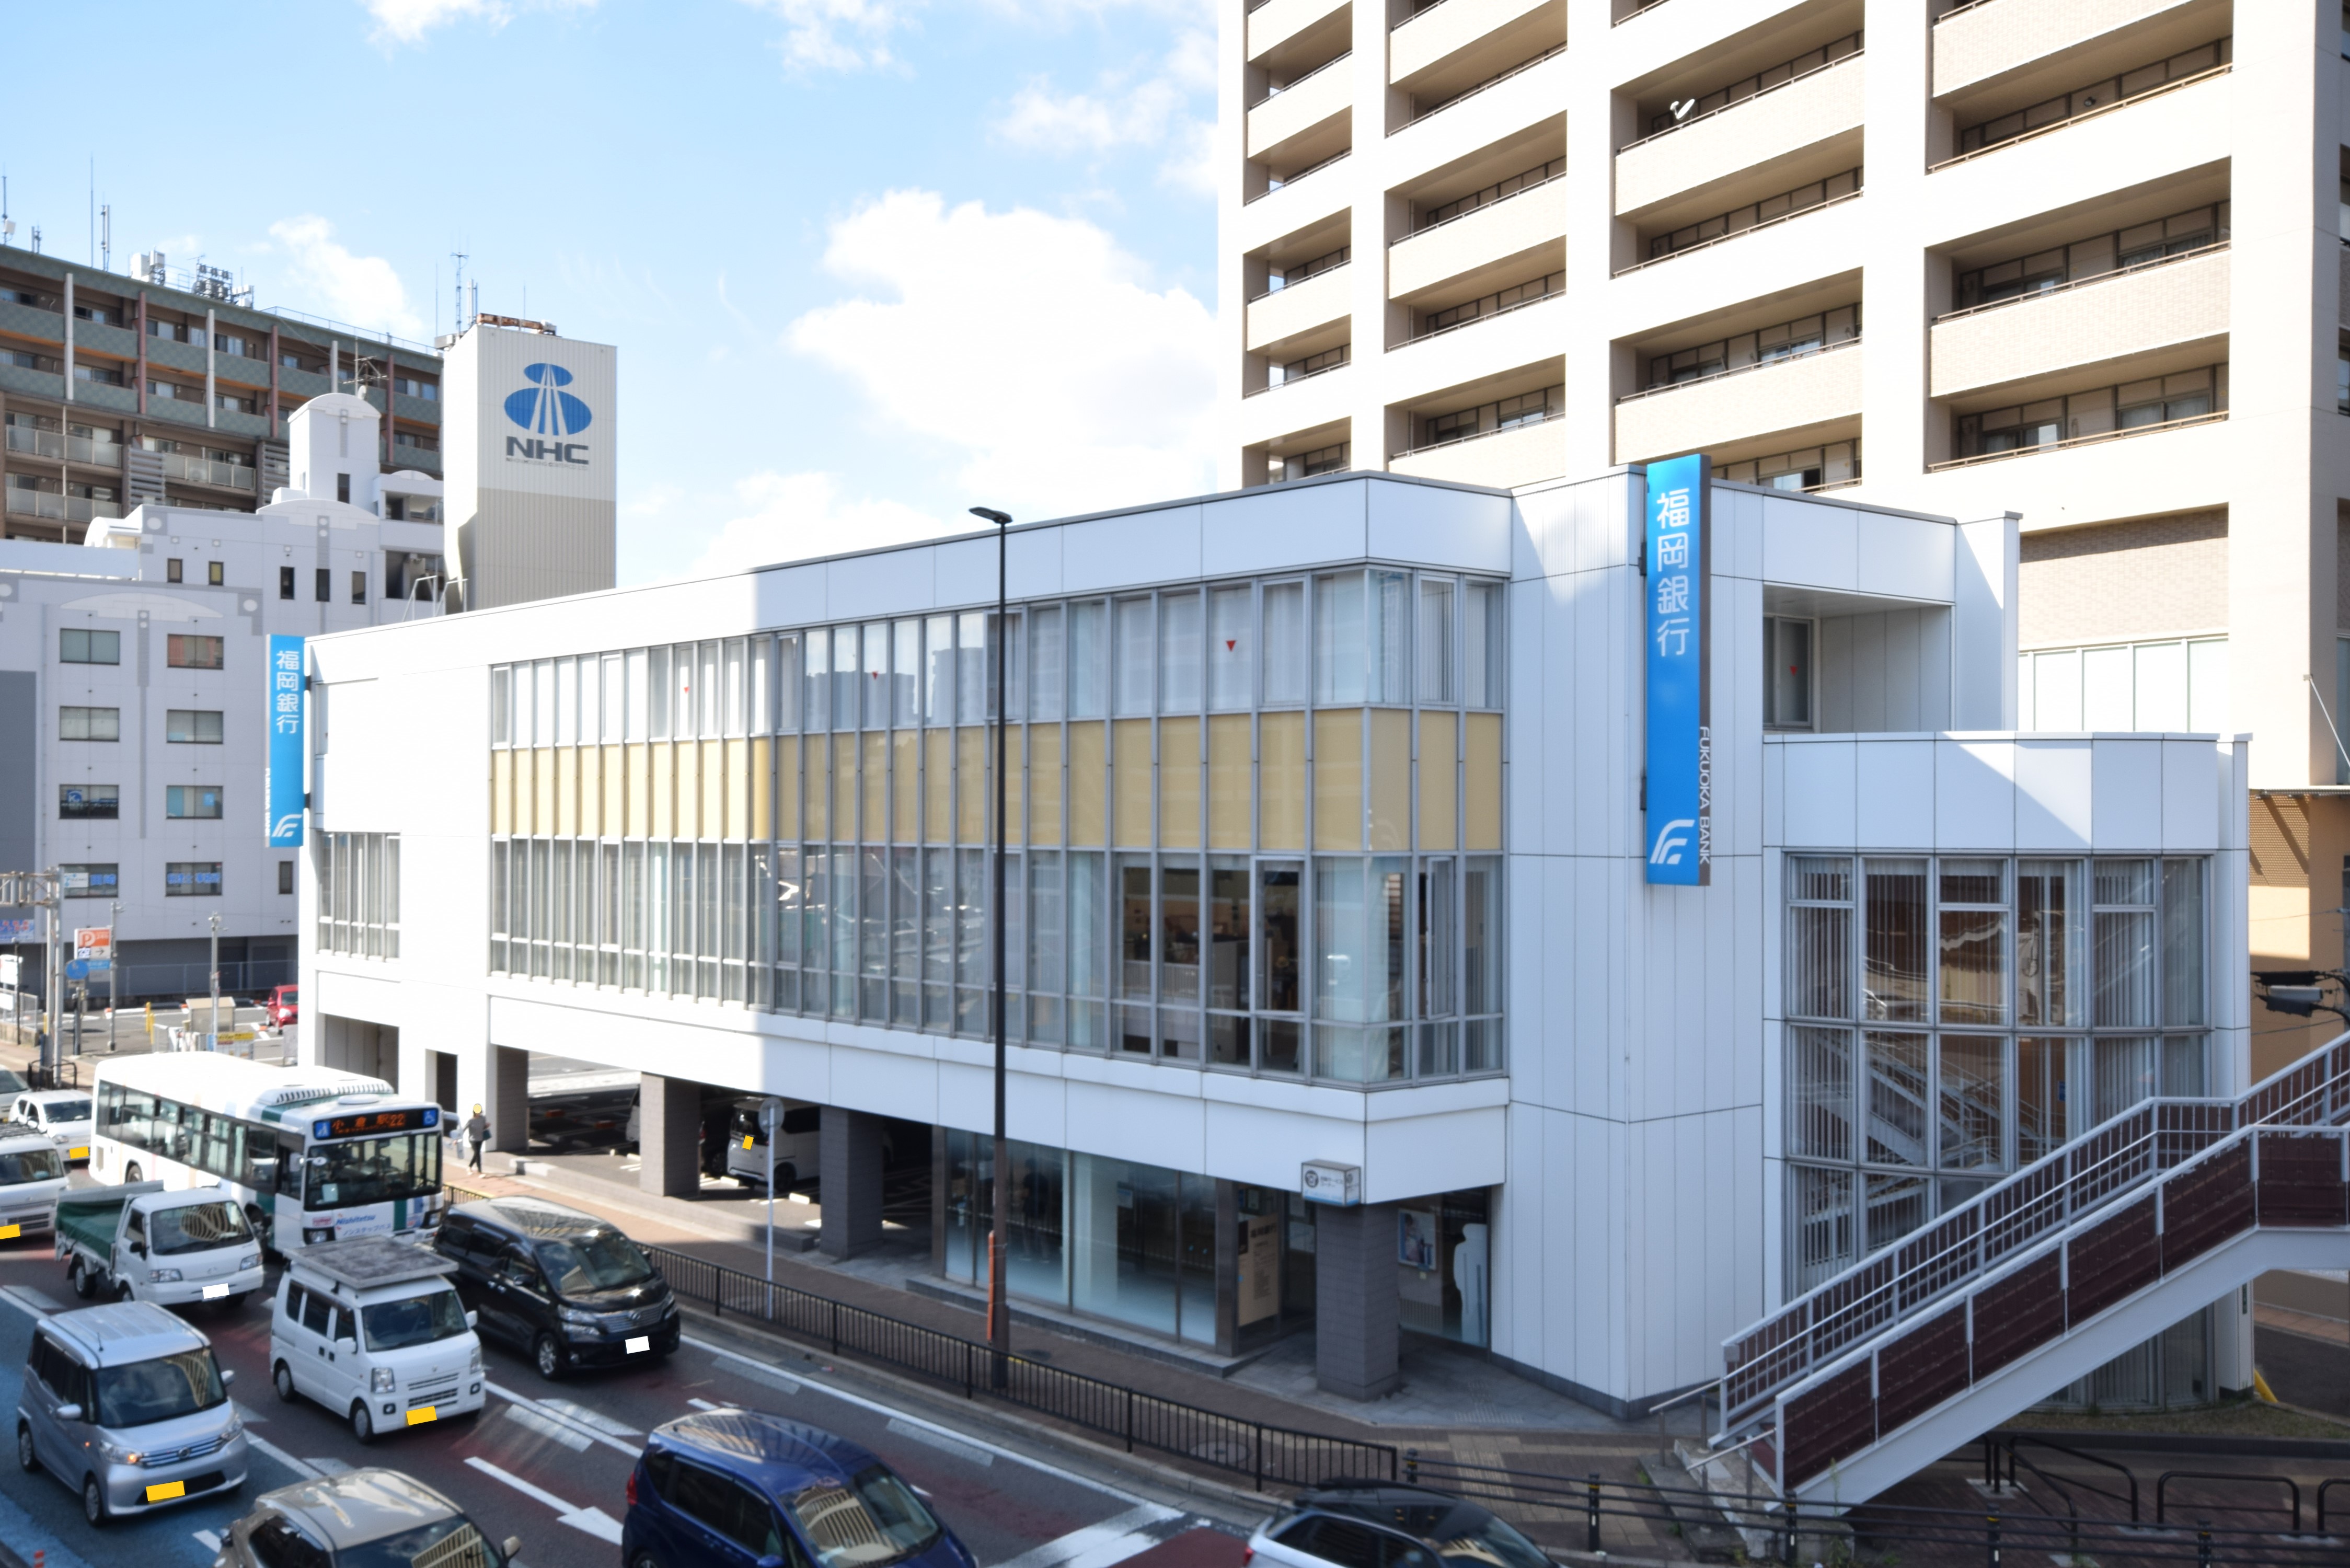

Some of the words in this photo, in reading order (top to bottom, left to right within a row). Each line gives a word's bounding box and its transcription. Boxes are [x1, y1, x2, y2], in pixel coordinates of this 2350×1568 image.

[506, 436, 589, 465] NHC
[1656, 488, 1690, 657] 福岡銀行
[276, 650, 299, 734] 福岡銀行
[1700, 727, 1710, 809] FUKUOKA
[1700, 816, 1710, 864] BANK
[336, 1215, 376, 1225] Nishitetsu
